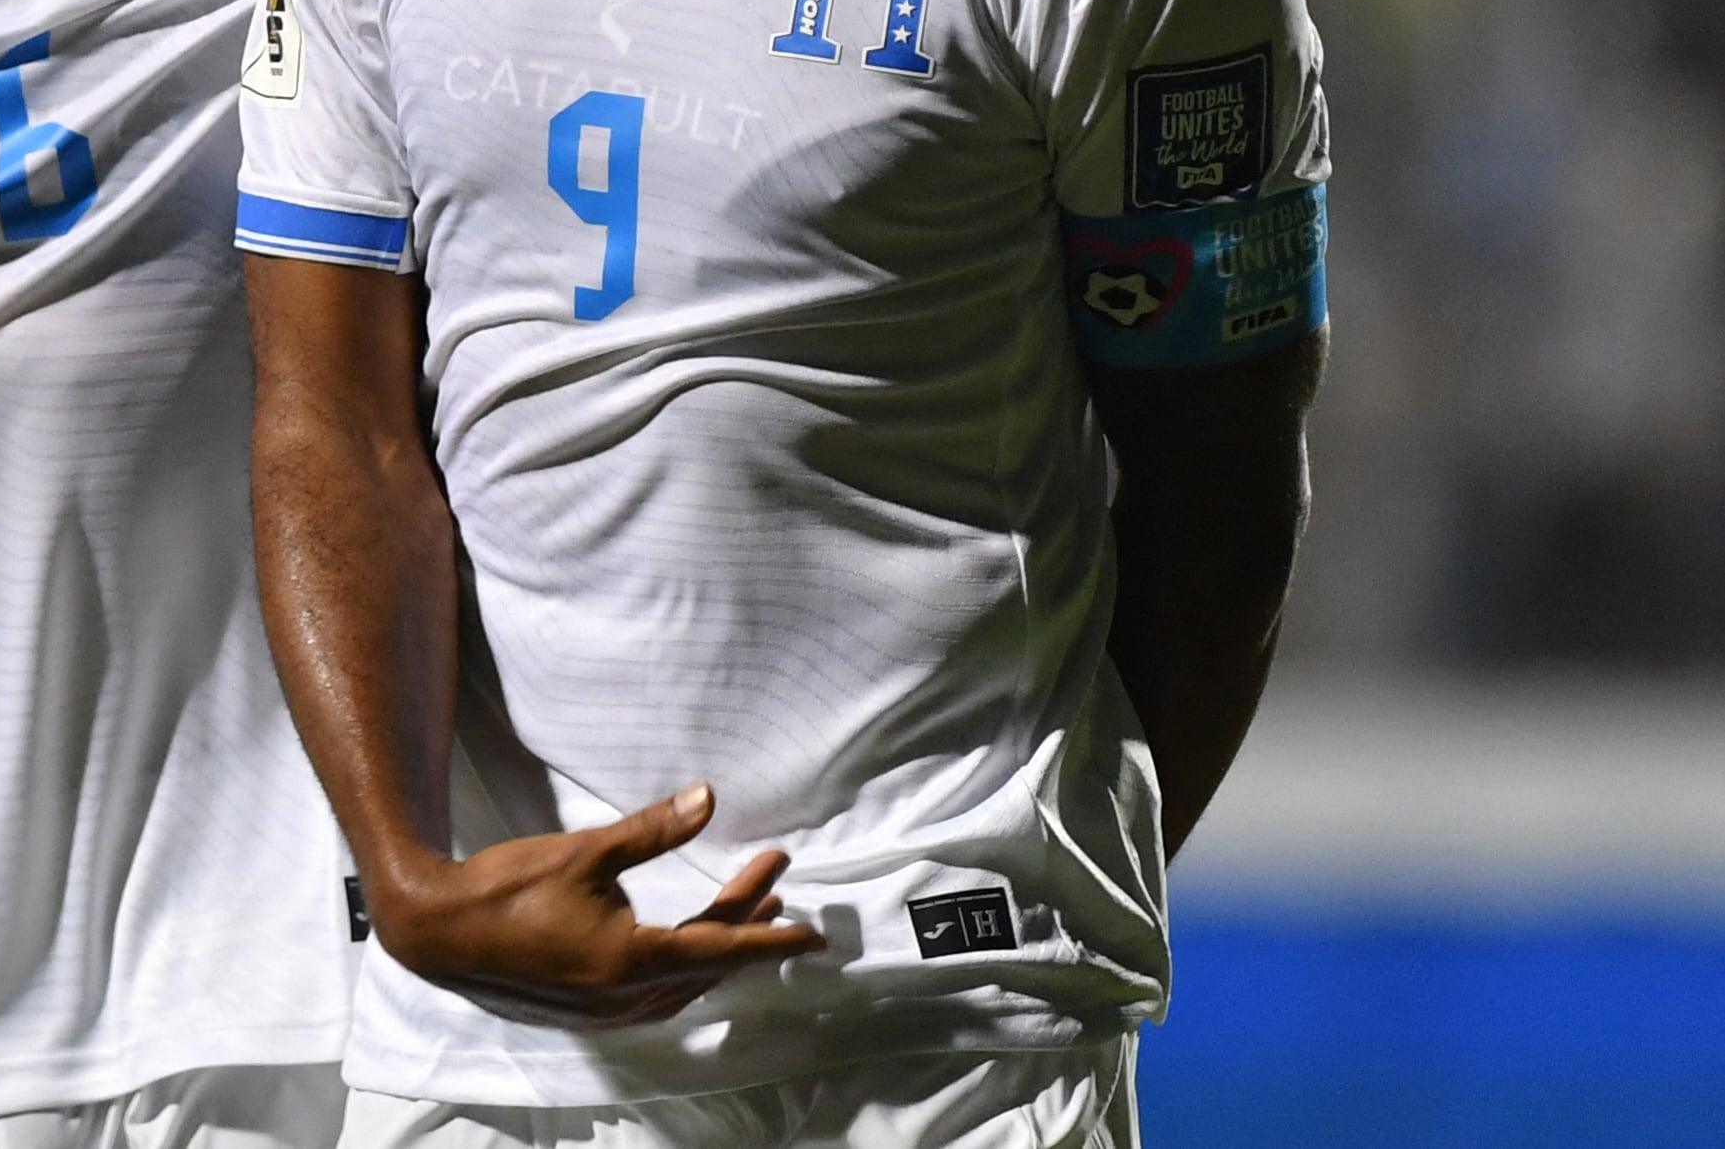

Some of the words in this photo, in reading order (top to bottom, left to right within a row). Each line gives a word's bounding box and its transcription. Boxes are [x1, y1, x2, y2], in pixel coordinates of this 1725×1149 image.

[444, 54, 763, 152] CATAULT
[1161, 81, 1245, 113] FOOTBALL
[1161, 103, 1245, 141] UNITES
[548, 90, 645, 322] 9
[1230, 304, 1289, 337] FIFA
